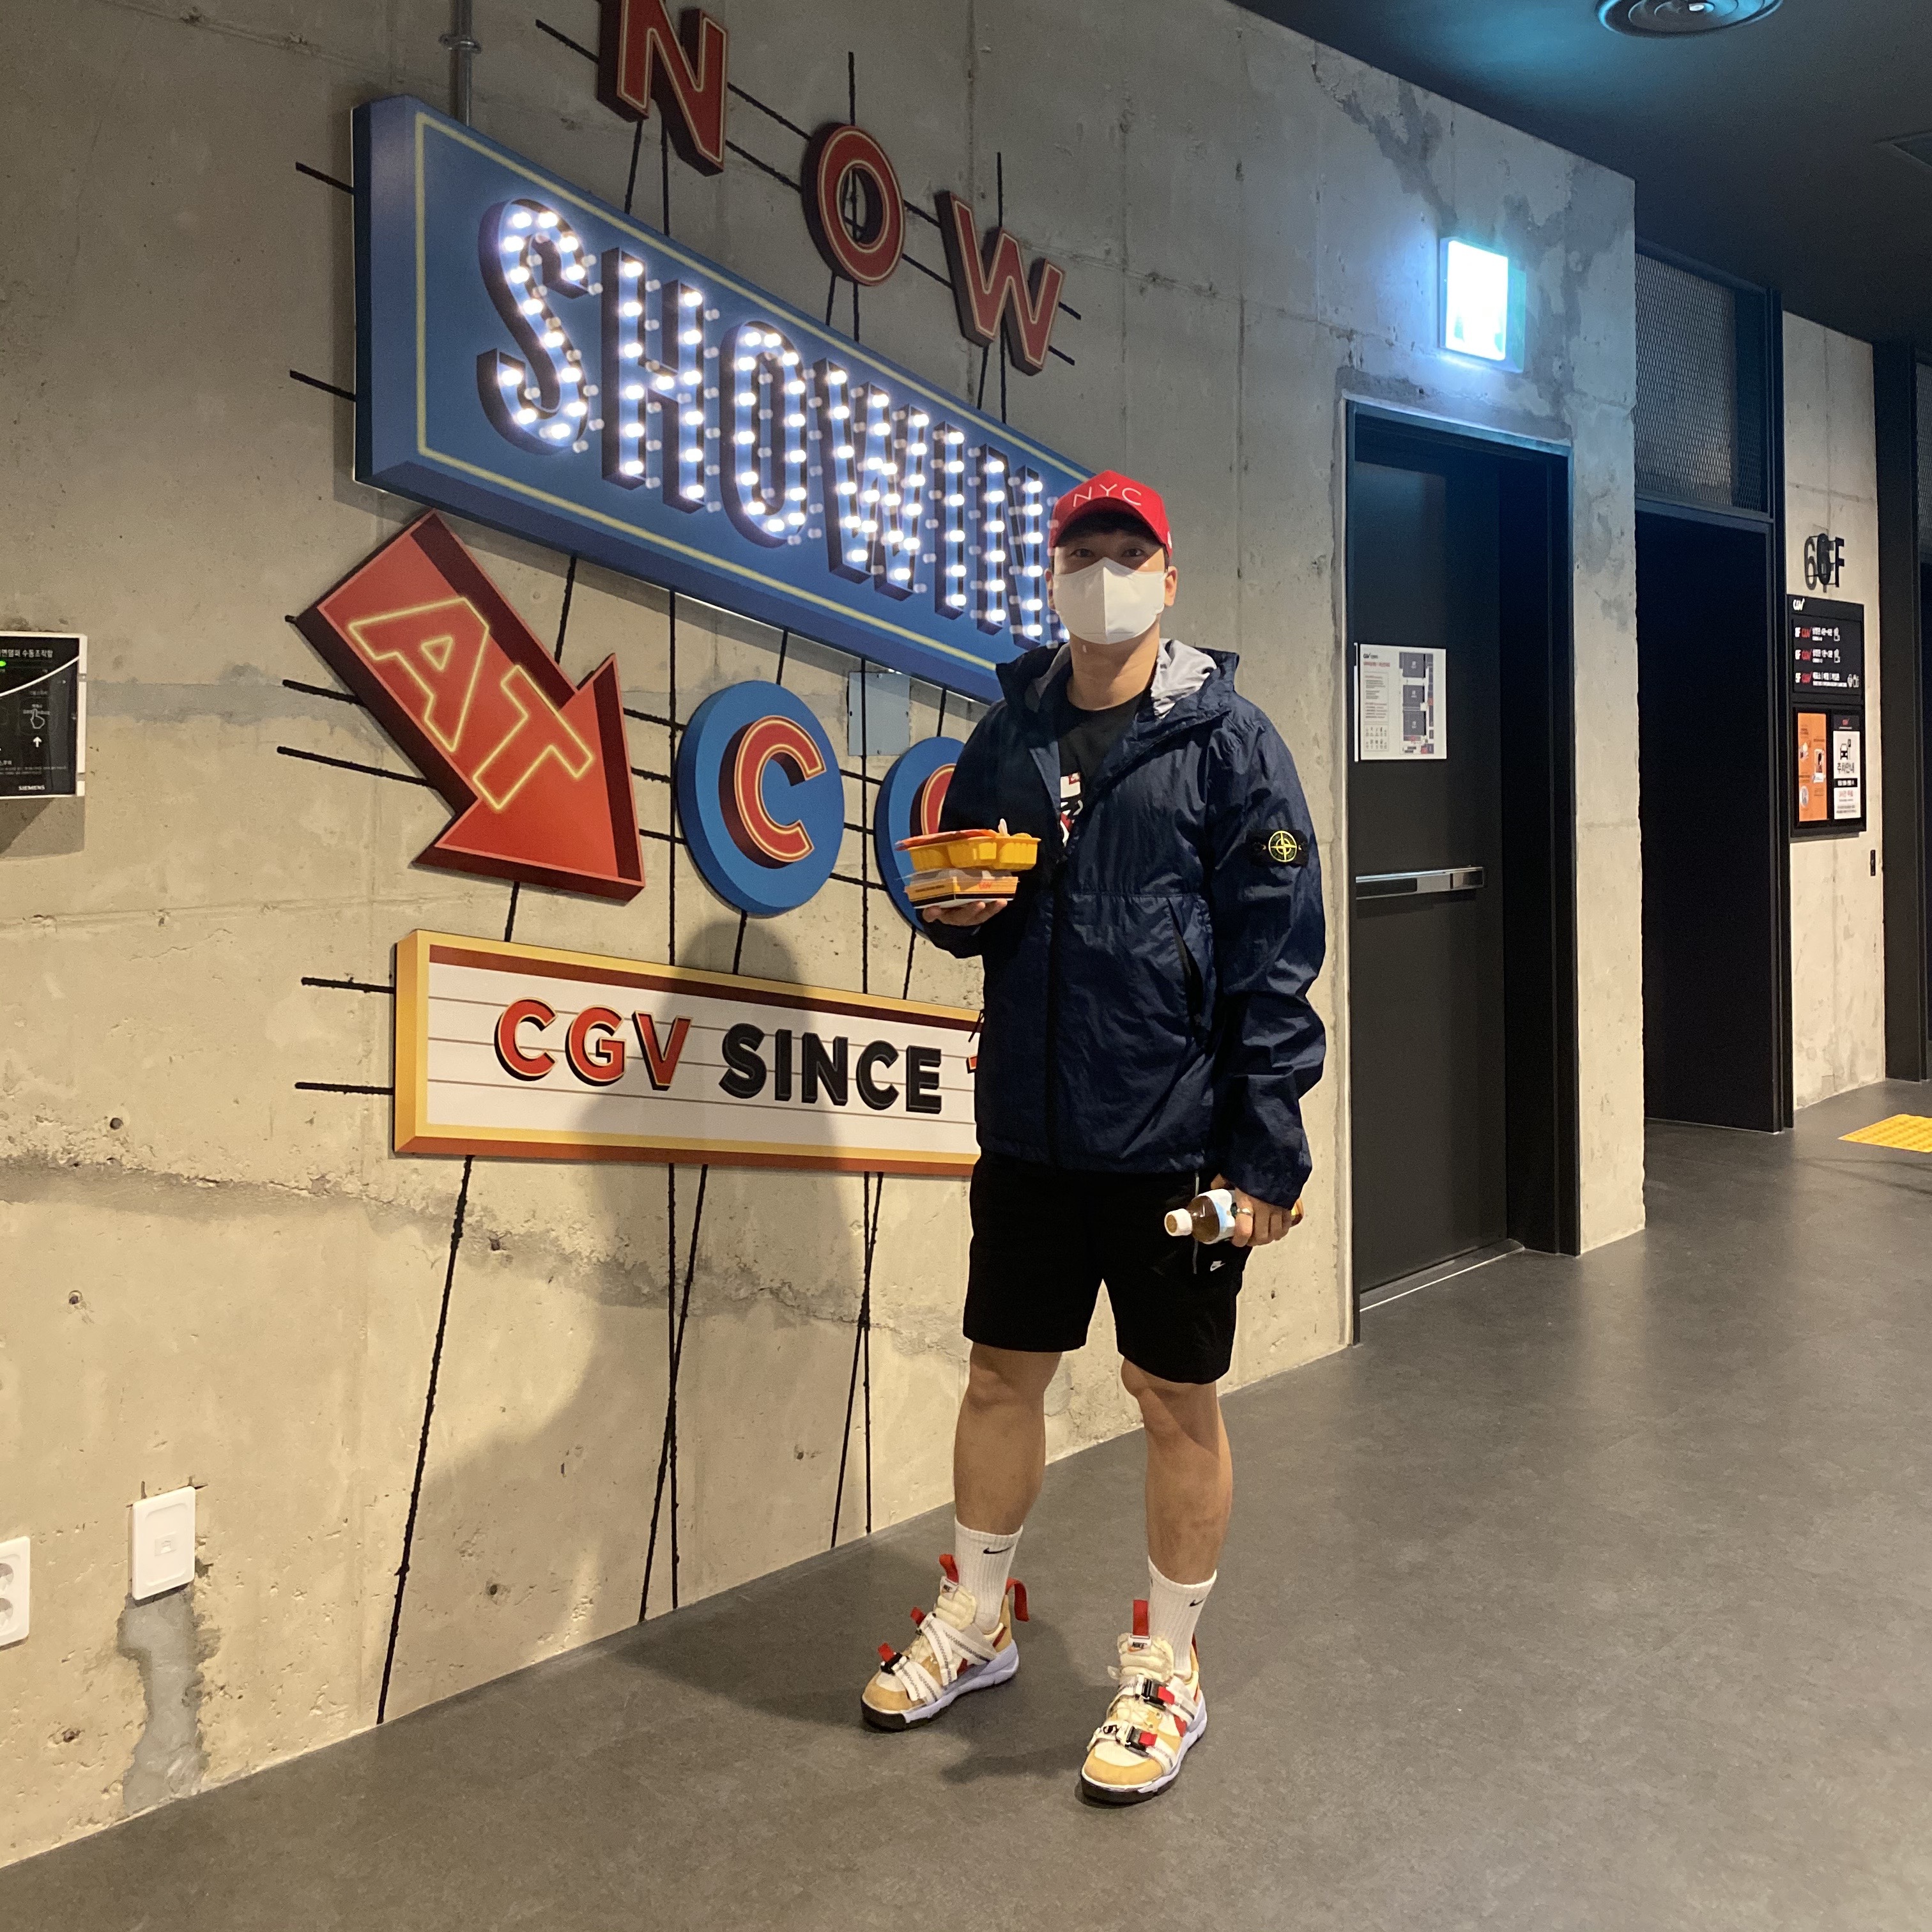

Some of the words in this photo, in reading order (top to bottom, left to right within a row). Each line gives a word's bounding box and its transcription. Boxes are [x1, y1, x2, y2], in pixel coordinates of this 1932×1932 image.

[598, 0, 1066, 376] NOW
[476, 198, 1071, 652] SHOWIN
[1073, 483, 1142, 507] NYC
[346, 595, 594, 811] AT
[494, 997, 694, 1091] CGV
[719, 1023, 942, 1113] SINCE
